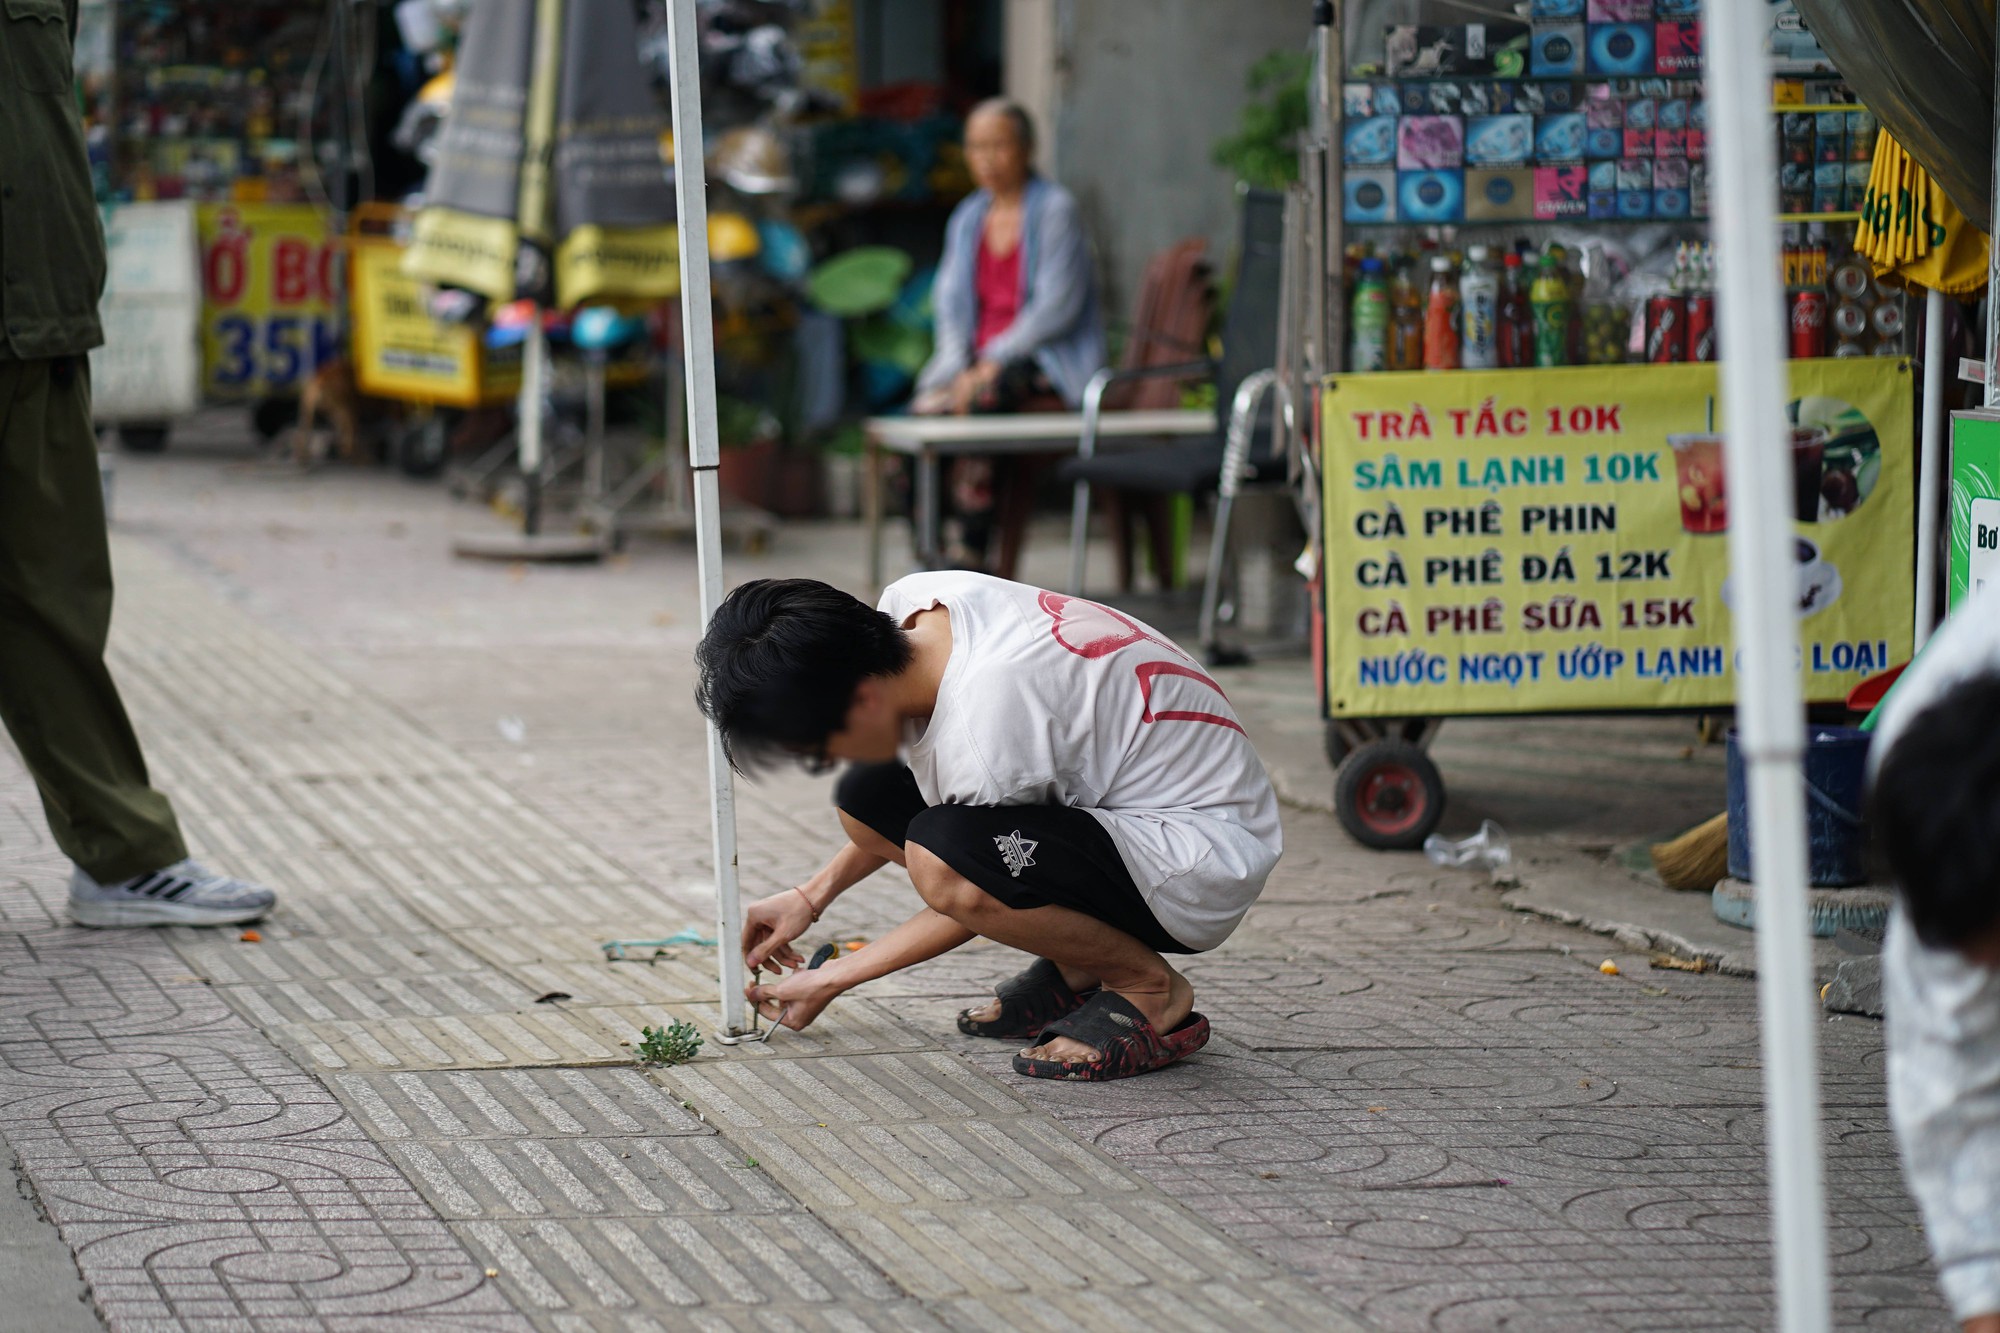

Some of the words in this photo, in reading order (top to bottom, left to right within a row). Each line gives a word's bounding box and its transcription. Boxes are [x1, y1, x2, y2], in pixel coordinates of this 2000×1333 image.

[1536, 200, 1587, 214] CRAVEN
[1353, 402, 1432, 439] TRÀ
[1448, 396, 1527, 437] TẮC
[1547, 404, 1622, 435] 10K
[1355, 453, 1441, 490] SÂM
[1458, 456, 1565, 492] LẠNH
[1585, 452, 1660, 483] 10K
[1355, 501, 1406, 538] CÀ
[1424, 500, 1502, 536] PHÊ
[1521, 503, 1616, 533] PHIN
[1977, 524, 1999, 550] Bơ
[1356, 551, 1407, 587] CÀ
[1425, 548, 1502, 585] PHÊ
[1522, 547, 1575, 582] ĐÁ
[1596, 550, 1671, 580] 12K
[1358, 600, 1408, 636] CÀ
[1426, 598, 1502, 634] PHÊ
[1523, 595, 1602, 630] SỮA
[1621, 598, 1696, 628] 15K
[1359, 649, 1447, 686] NƯỚC
[1460, 651, 1544, 687] NGỌT
[1558, 643, 1624, 680] ƯỚP
[1636, 646, 1722, 683] LẠNH
[1812, 640, 1887, 676] LOẠI
